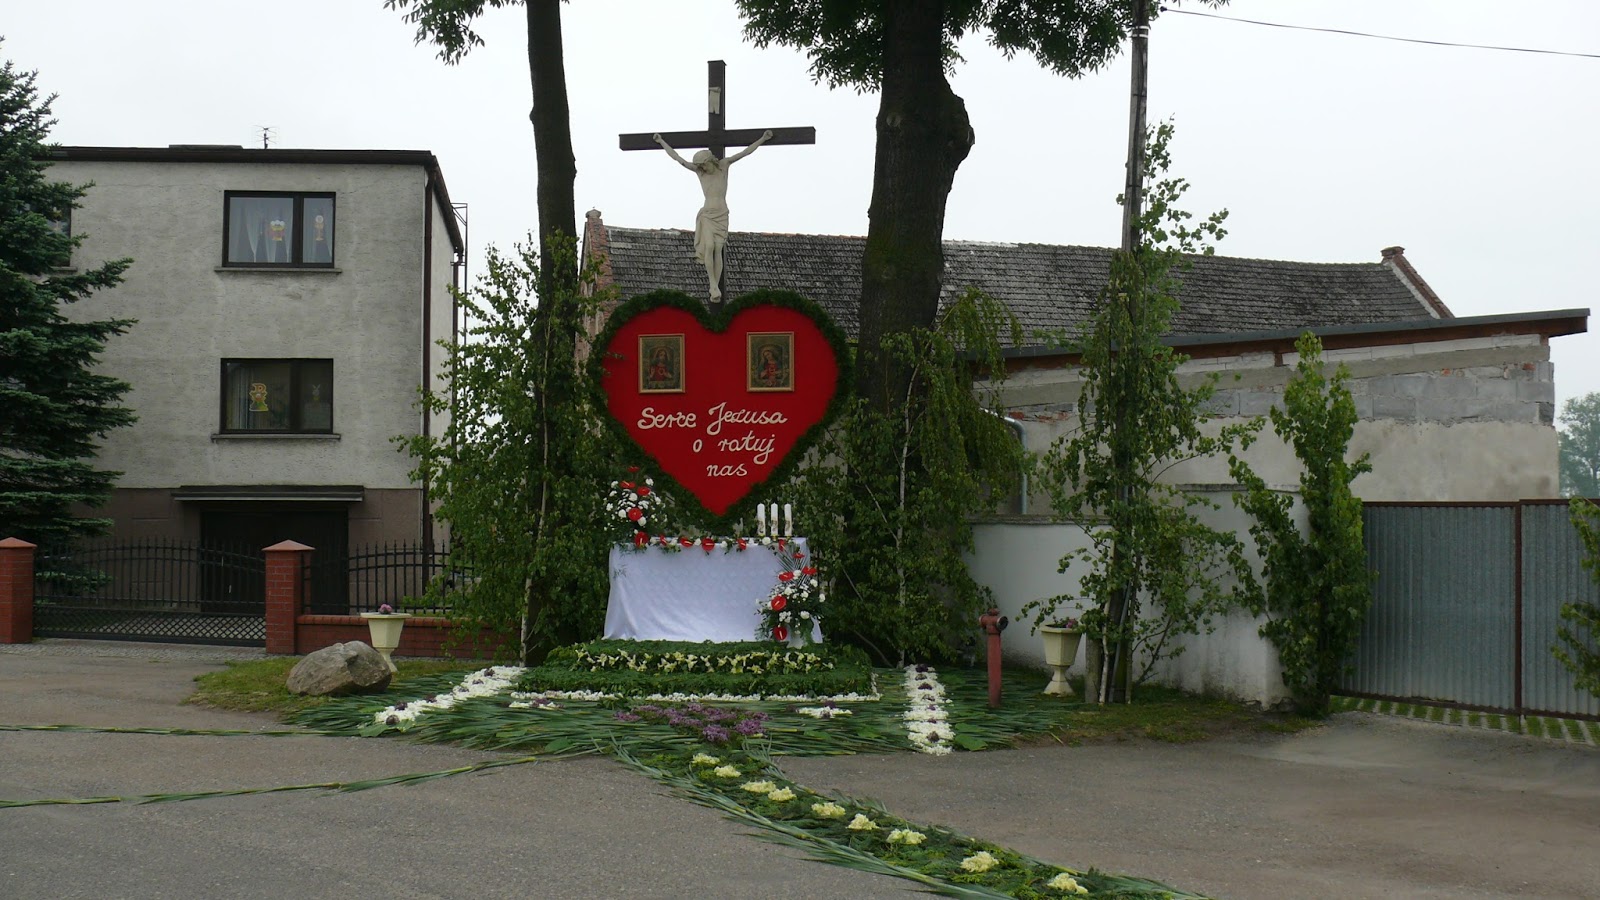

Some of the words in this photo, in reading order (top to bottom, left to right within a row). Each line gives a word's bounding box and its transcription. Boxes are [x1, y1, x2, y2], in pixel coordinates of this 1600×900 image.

[637, 407, 697, 430] Serce
[706, 400, 788, 437] Jezusa
[693, 438, 703, 453] o
[717, 430, 776, 465] ratuj
[706, 463, 748, 477] nas
